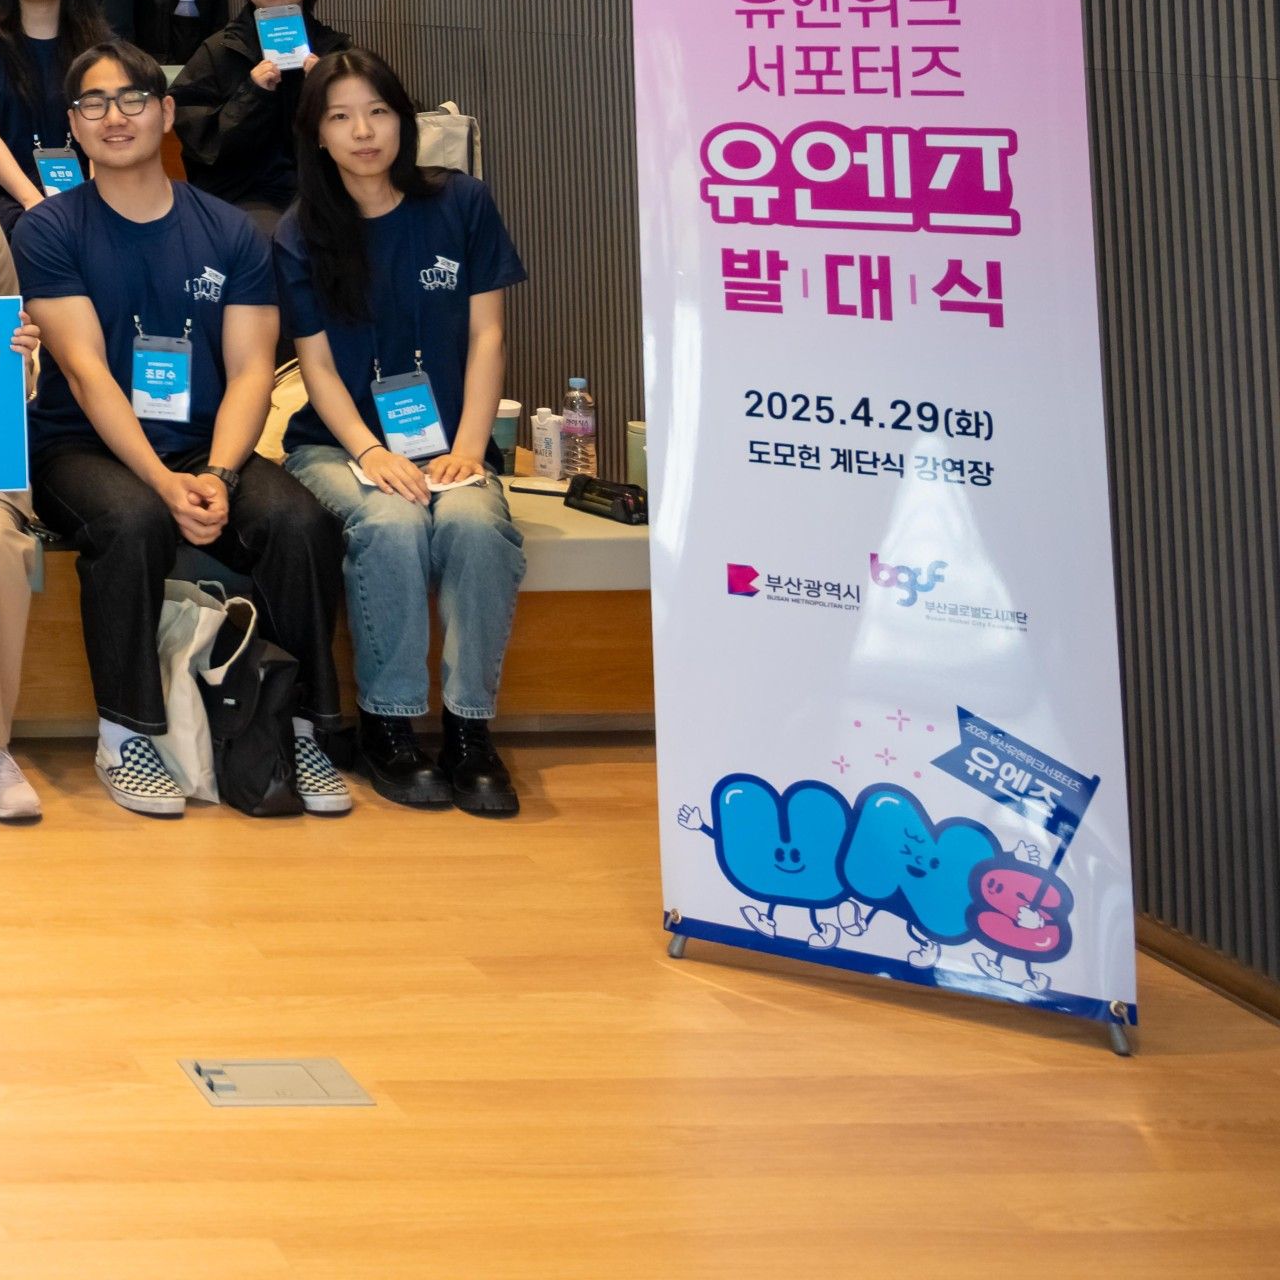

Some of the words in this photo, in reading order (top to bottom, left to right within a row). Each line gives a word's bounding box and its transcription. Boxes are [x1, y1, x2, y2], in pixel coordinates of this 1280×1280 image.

[738, 44, 965, 97] 서포터즈
[745, 390, 993, 442] 2025.4.29(화)
[749, 440, 821, 473] 도모헌
[830, 447, 904, 478] 계단식
[914, 456, 993, 487] 강연장
[765, 574, 860, 603] 부산광역시
[767, 594, 789, 602] BUSAN
[791, 598, 842, 609] METROPOLITAN
[965, 747, 1062, 817] 유엔즈
